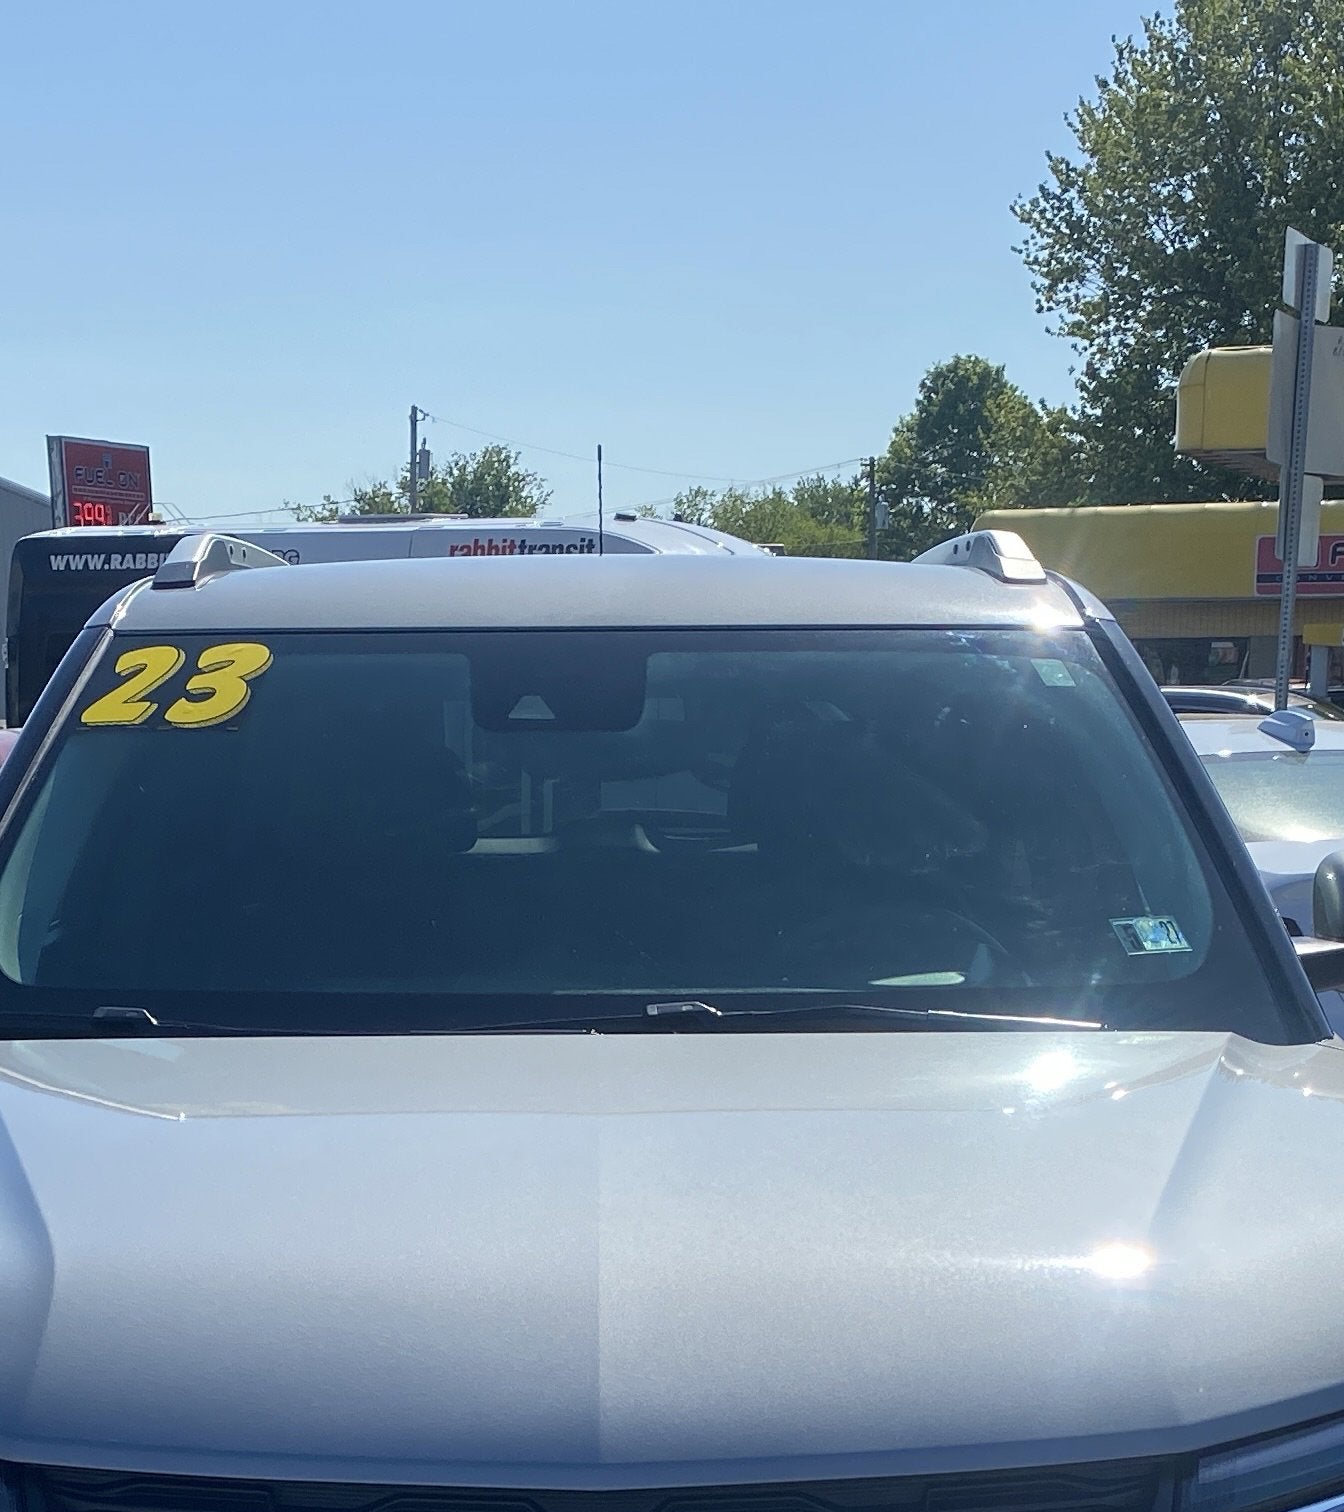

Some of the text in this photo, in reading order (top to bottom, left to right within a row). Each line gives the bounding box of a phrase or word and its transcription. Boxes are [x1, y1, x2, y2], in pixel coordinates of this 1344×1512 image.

[74, 465, 142, 491] FUEL ON
[81, 642, 274, 729] 23
